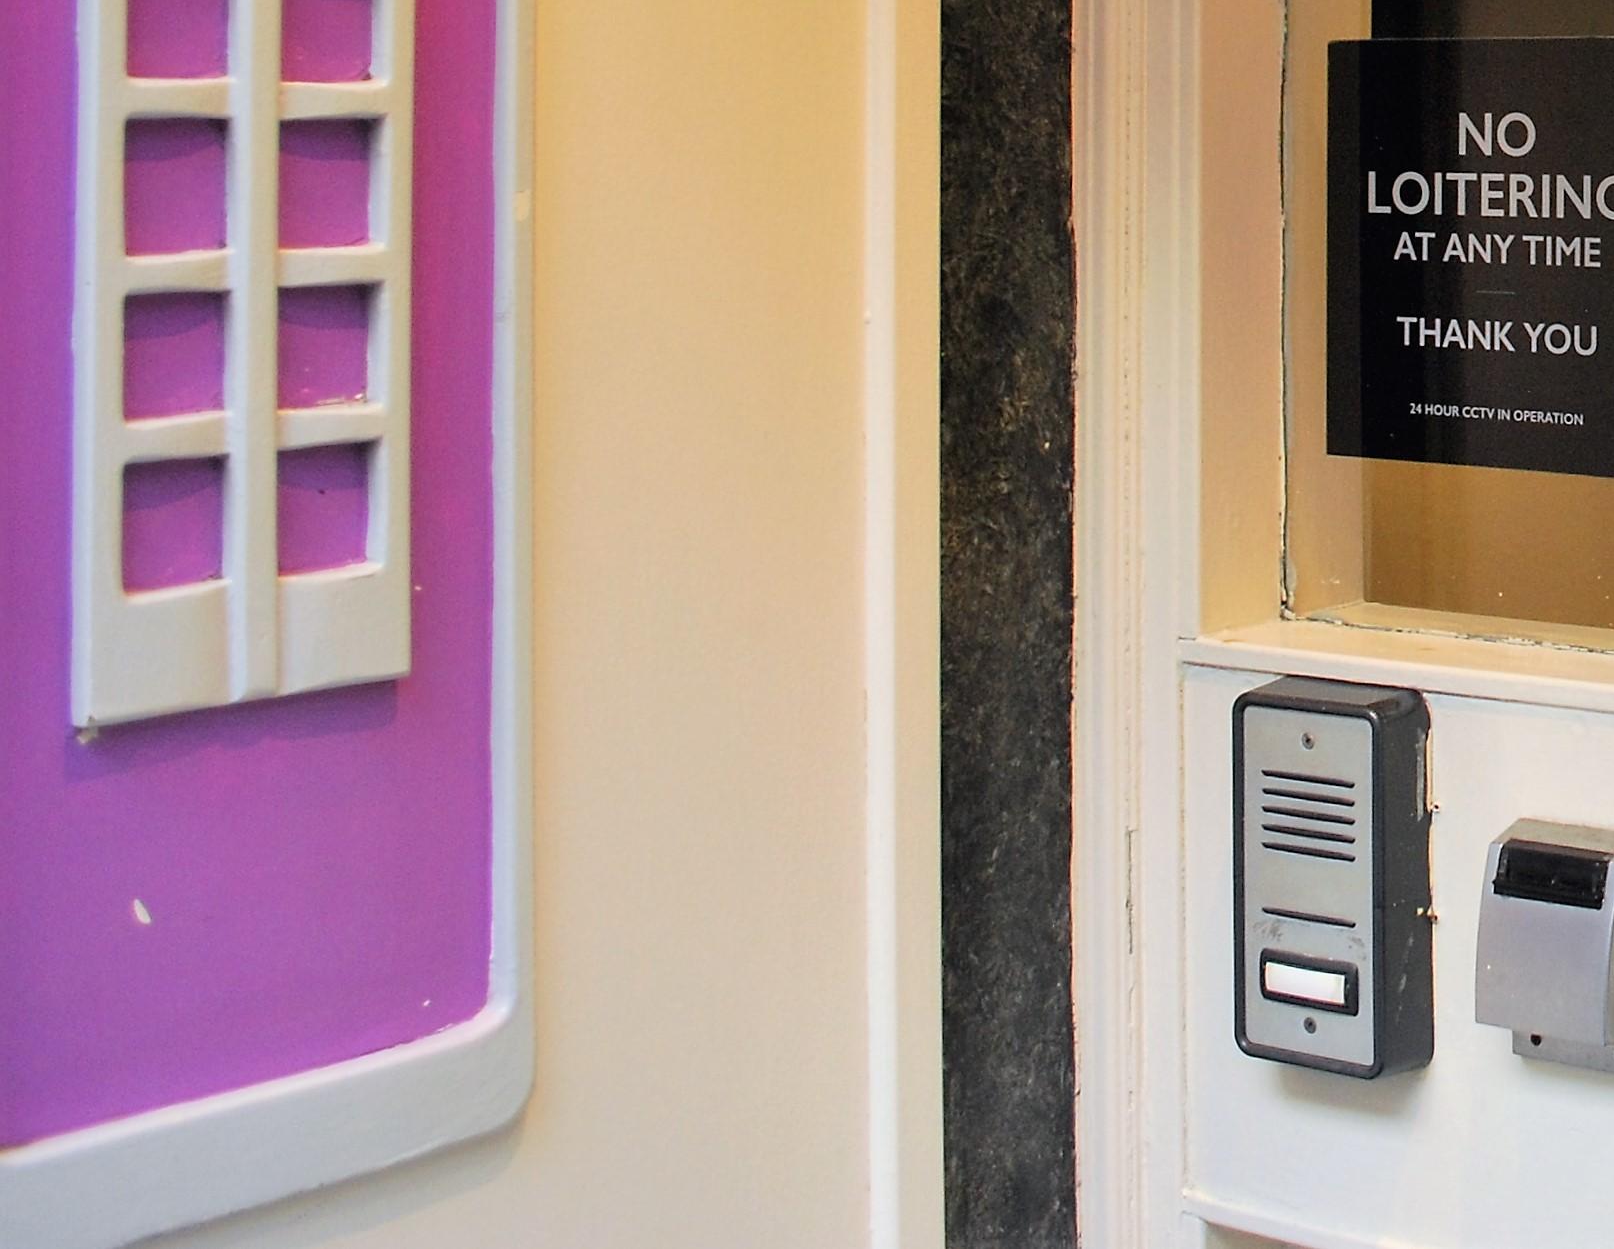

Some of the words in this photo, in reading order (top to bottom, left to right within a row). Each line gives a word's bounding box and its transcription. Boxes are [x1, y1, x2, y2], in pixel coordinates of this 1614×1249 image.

[1457, 111, 1537, 158] NO
[1393, 231, 1436, 261] AT
[1442, 233, 1516, 265] ANY
[1522, 235, 1602, 268] TIME
[1396, 316, 1516, 353] THANK
[1523, 322, 1599, 356] YOU
[1409, 403, 1422, 415] 24
[1424, 404, 1460, 417] HOUR
[1462, 406, 1496, 420] CCTV
[1497, 409, 1511, 421] IN
[1513, 410, 1584, 426] OPERATION
